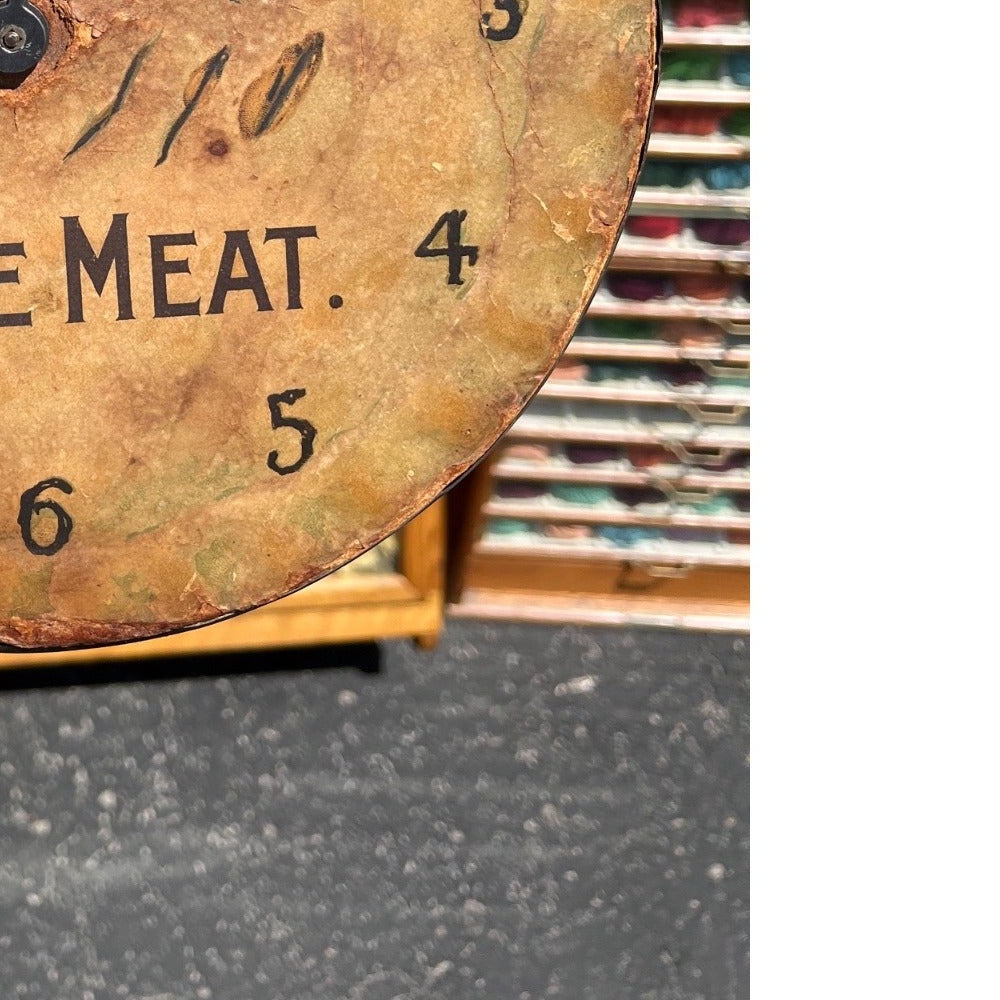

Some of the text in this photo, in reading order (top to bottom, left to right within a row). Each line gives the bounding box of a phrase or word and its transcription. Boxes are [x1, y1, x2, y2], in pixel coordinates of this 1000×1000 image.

[413, 208, 481, 287] 4
[265, 387, 319, 477] 5
[15, 476, 75, 558] 6
